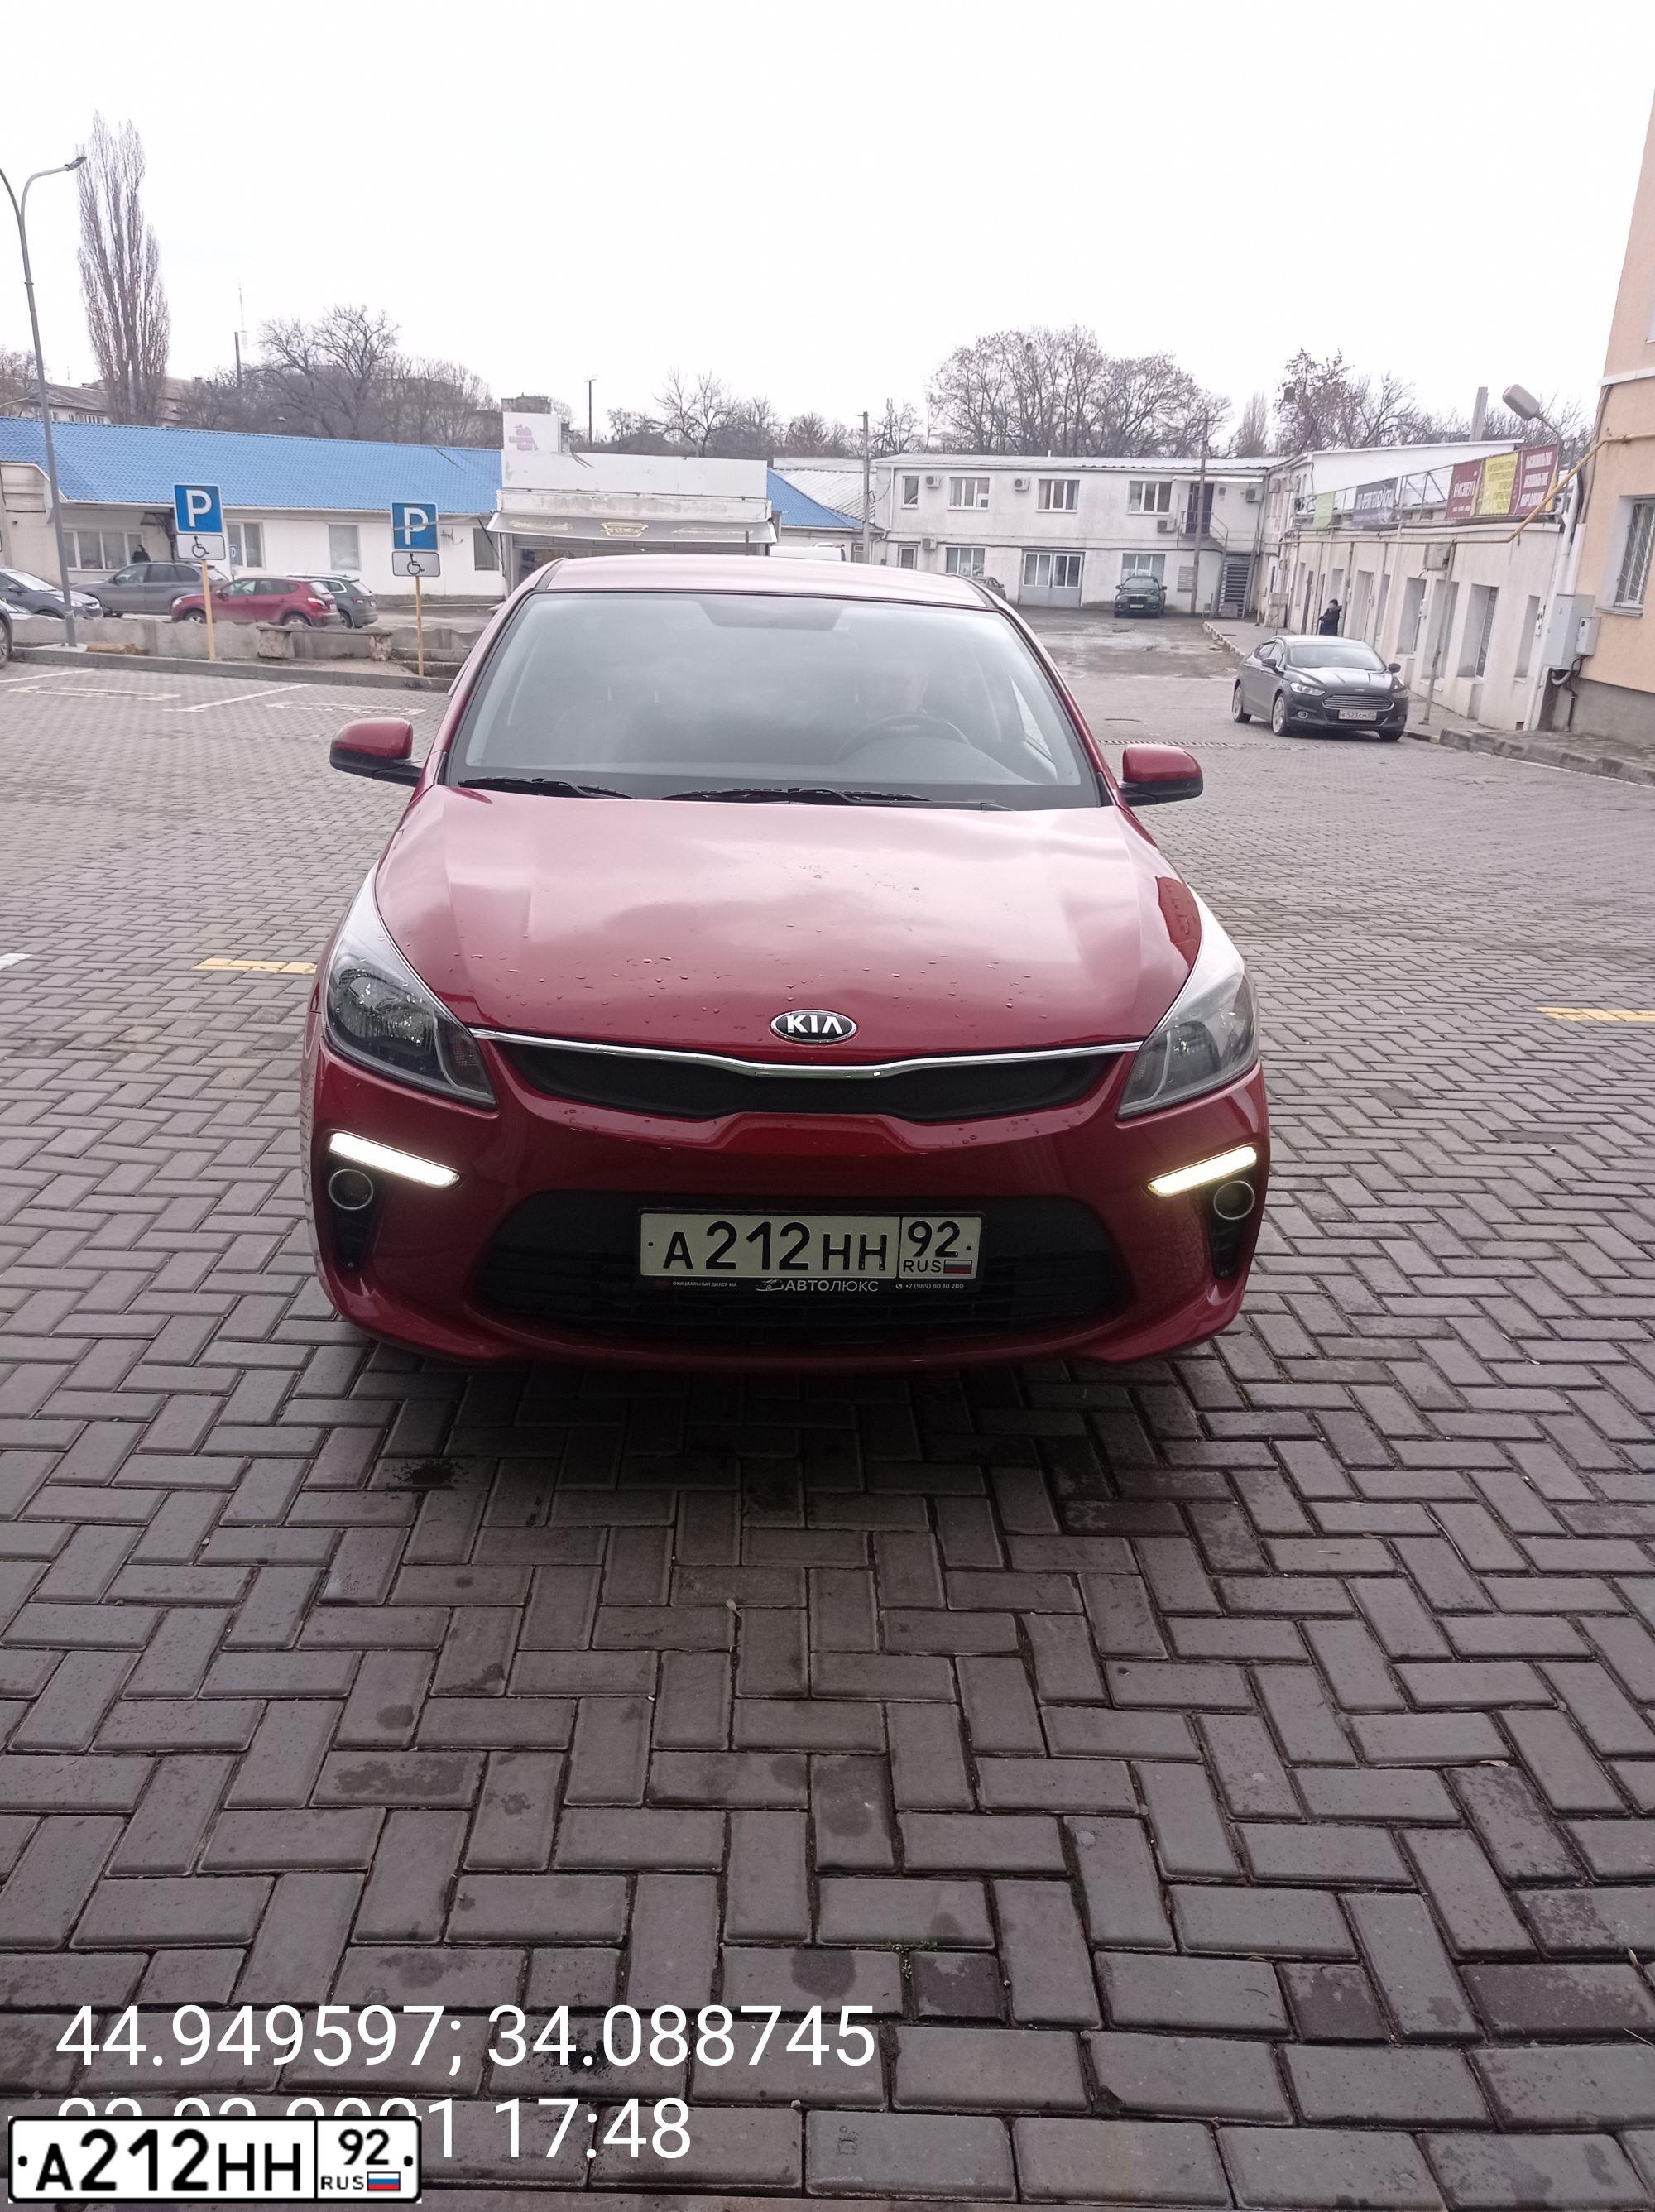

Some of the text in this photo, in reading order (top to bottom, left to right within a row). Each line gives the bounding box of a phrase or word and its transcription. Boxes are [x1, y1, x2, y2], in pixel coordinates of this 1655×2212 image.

[186, 490, 213, 527] P
[404, 507, 429, 545] P
[786, 1015, 844, 1034] KIA
[907, 1221, 960, 1257] 92
[903, 1260, 941, 1273] RUS
[784, 1279, 879, 1292] АВТОЛЮКС
